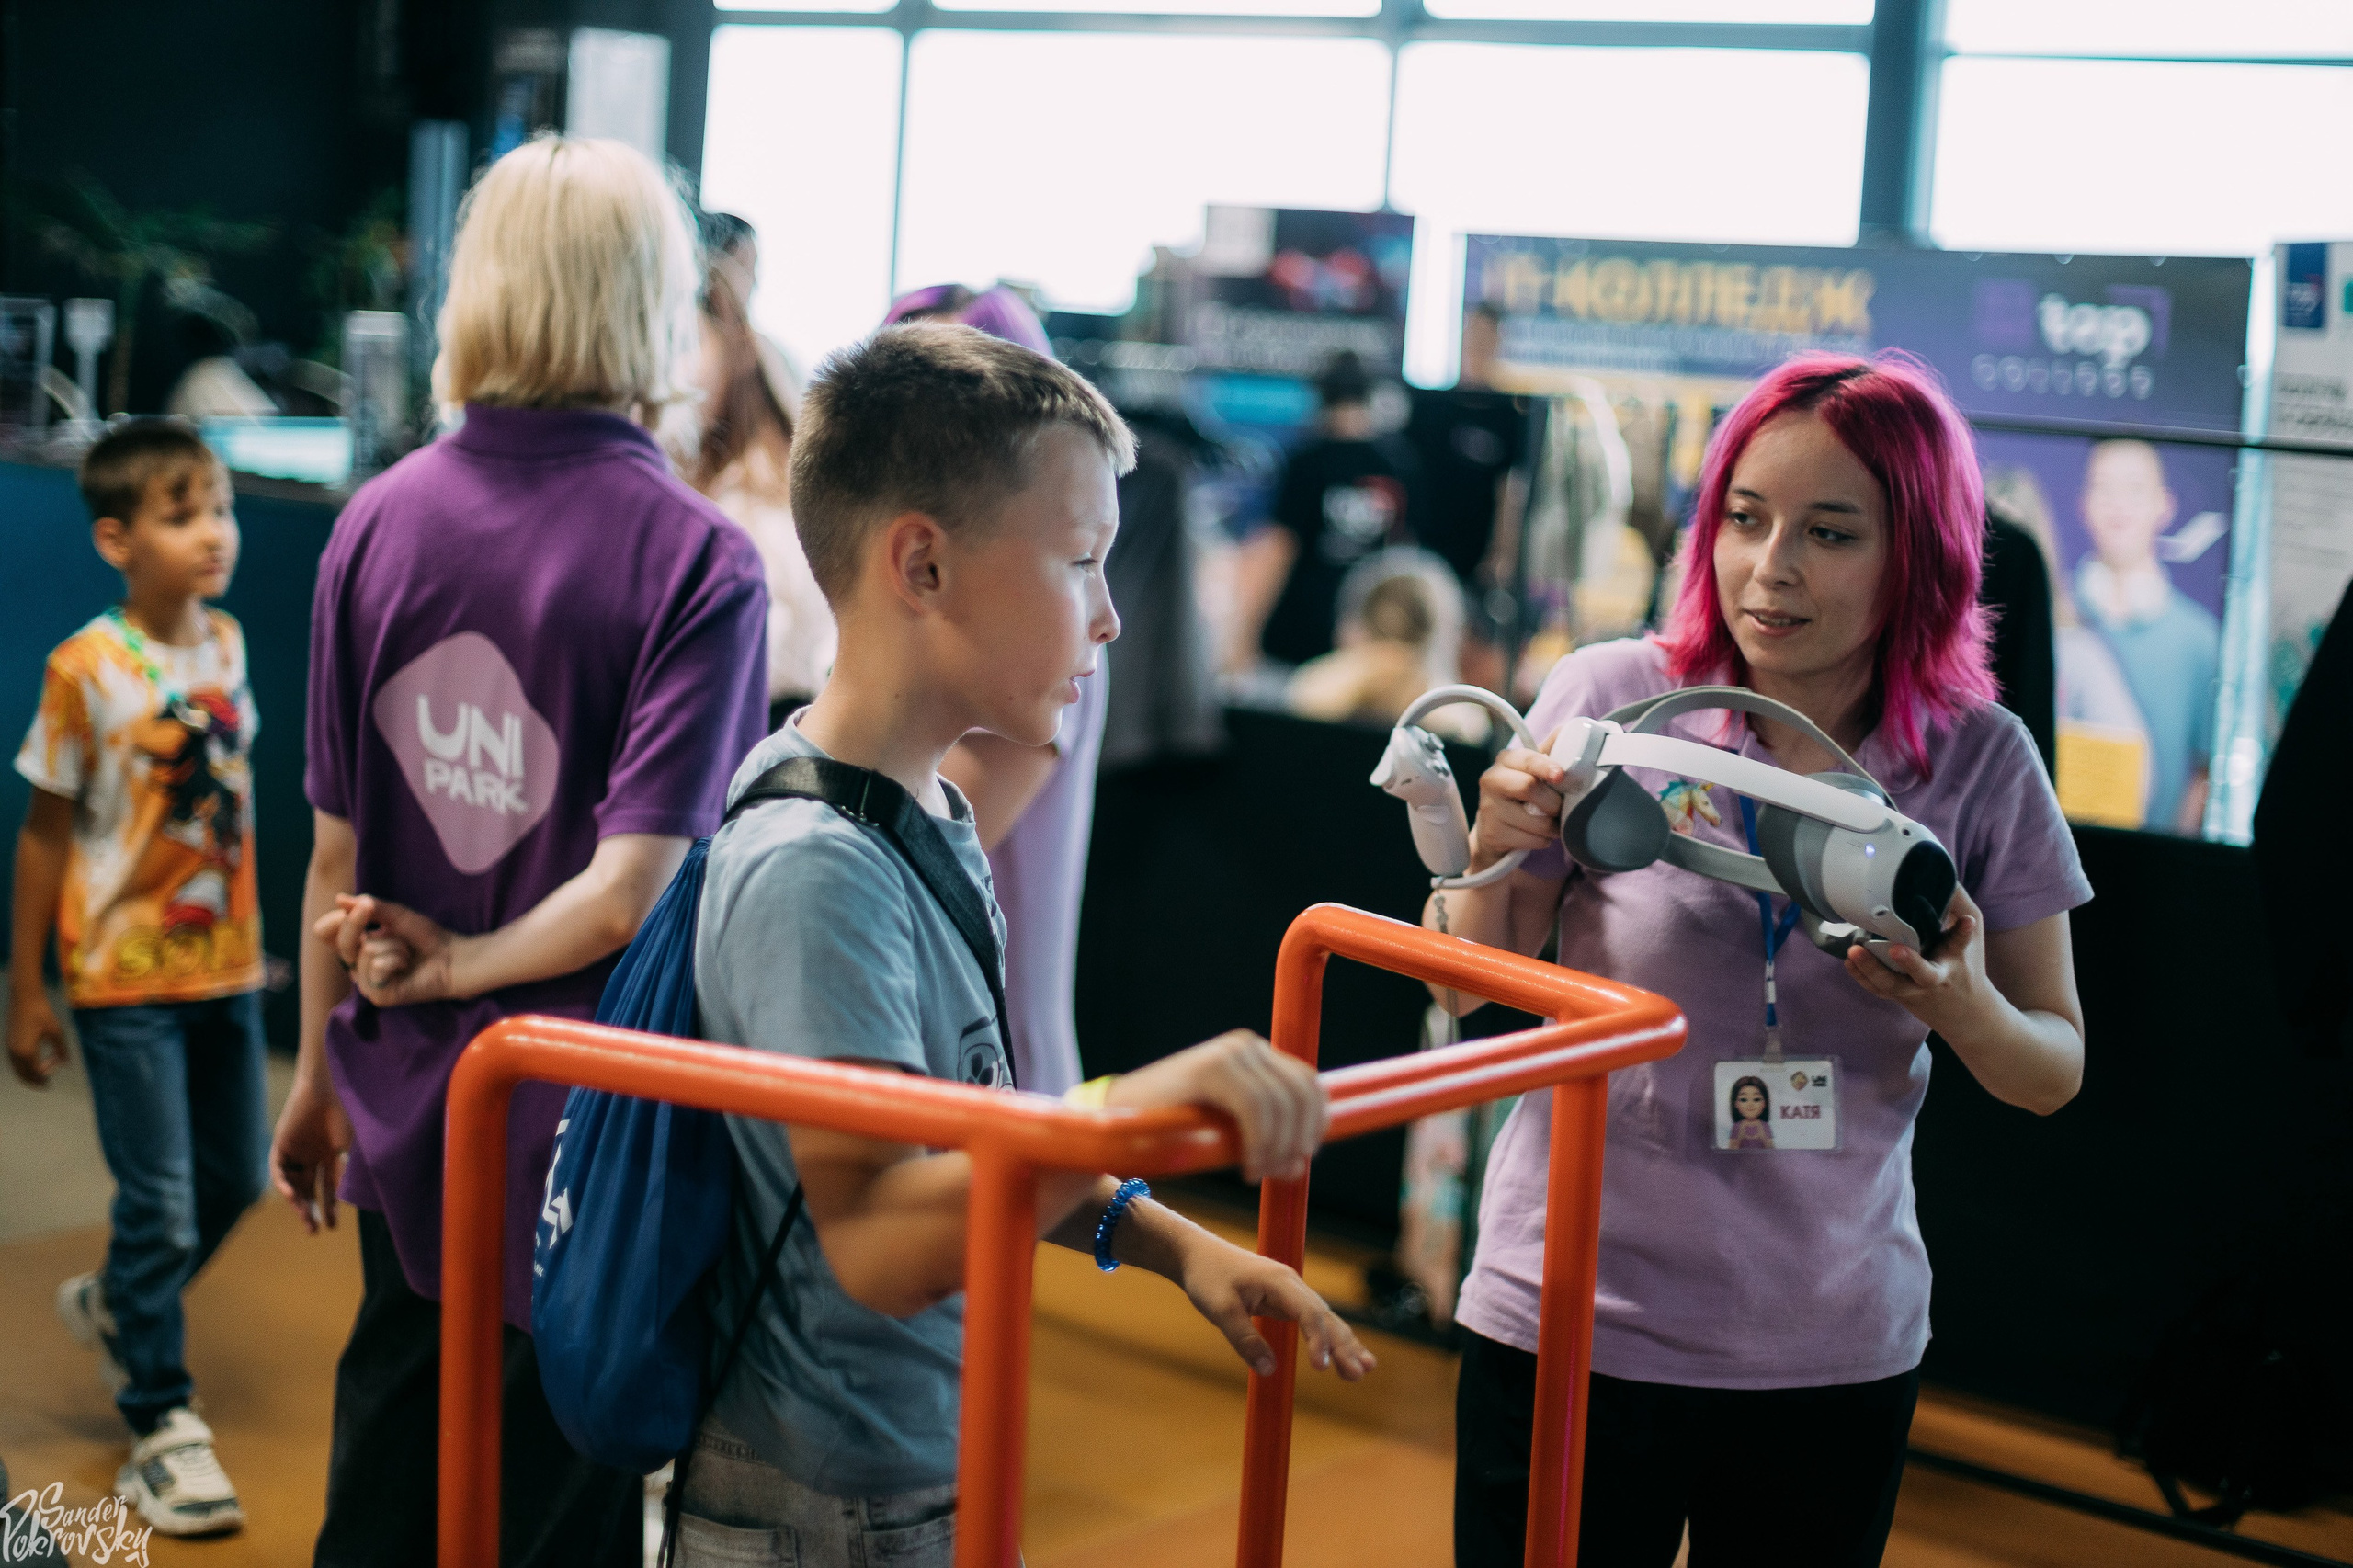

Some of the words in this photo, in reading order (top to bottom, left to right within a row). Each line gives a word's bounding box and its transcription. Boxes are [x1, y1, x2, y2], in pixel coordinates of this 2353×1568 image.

[416, 693, 524, 780] UNI
[424, 756, 529, 815] PARK
[1779, 1104, 1821, 1119] КАТЯ
